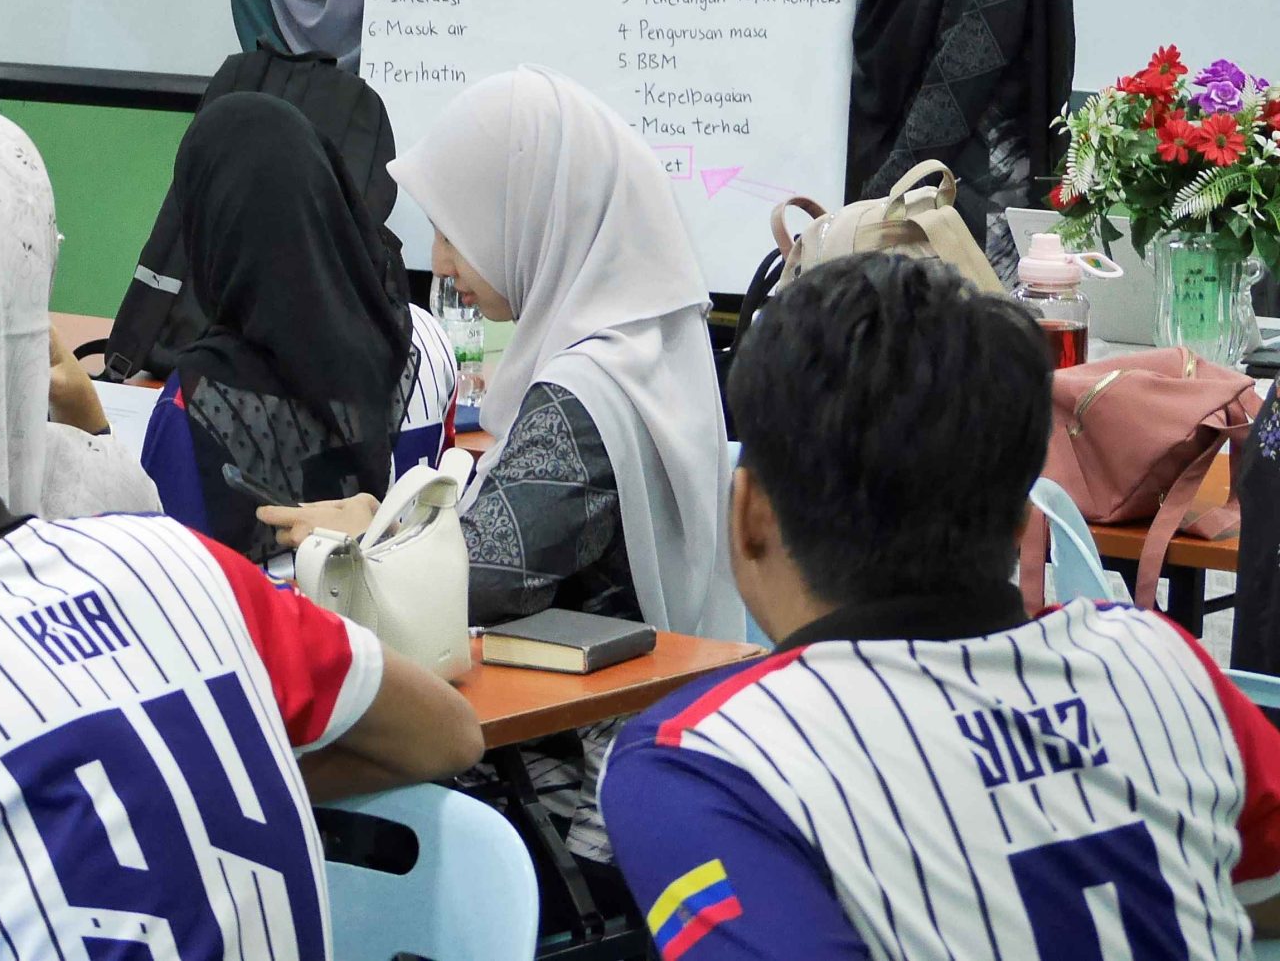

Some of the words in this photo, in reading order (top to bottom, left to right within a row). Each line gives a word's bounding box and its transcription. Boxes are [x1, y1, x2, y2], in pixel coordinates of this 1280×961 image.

[385, 19, 439, 37] Masuk
[447, 23, 469, 37] air
[639, 19, 724, 48] Pengurusan
[729, 25, 768, 40] masa
[637, 52, 677, 70] BBM
[384, 60, 467, 84] Perihatin
[642, 116, 687, 136] Masa
[692, 116, 751, 136] terhad
